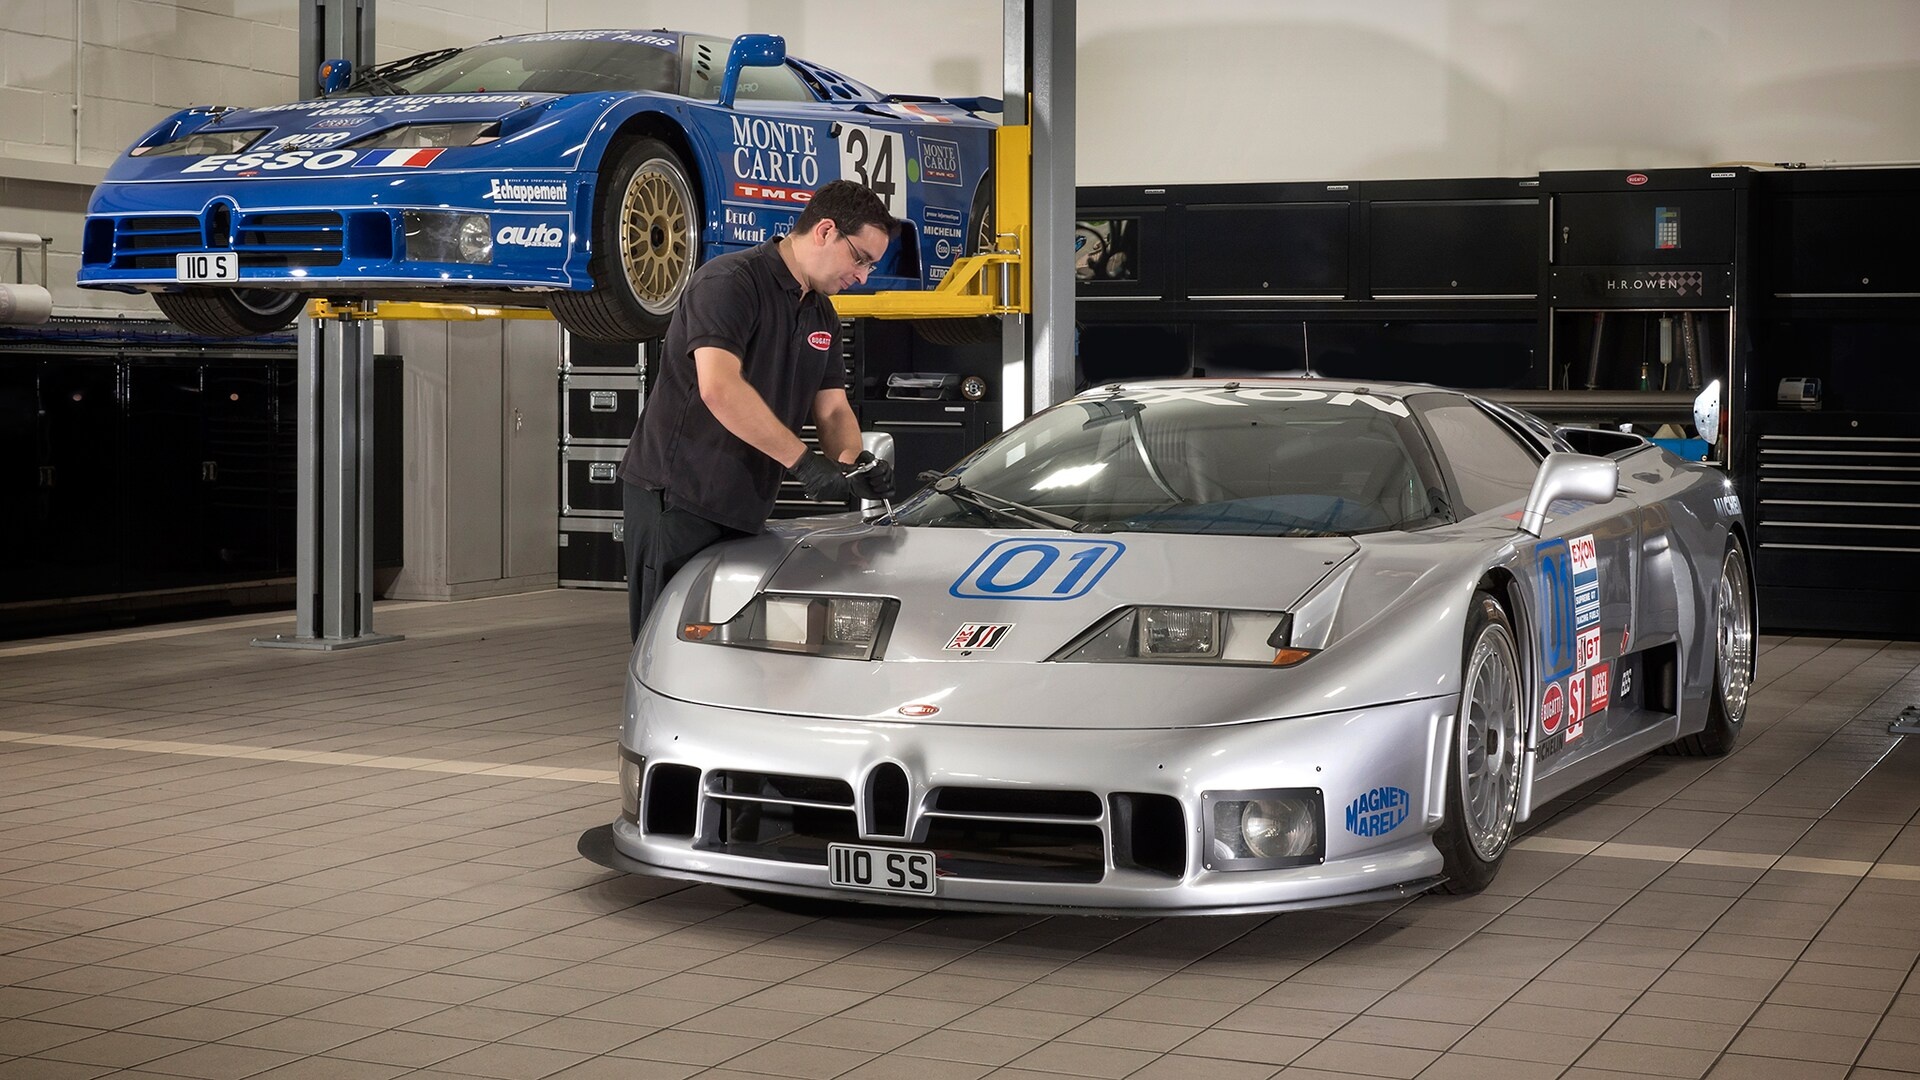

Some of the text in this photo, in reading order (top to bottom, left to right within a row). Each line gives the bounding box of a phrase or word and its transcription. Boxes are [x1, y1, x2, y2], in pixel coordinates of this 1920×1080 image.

[612, 33, 676, 47] PARIS
[267, 132, 351, 146] AUTO
[730, 115, 817, 156] MONTE
[180, 149, 358, 173] ESSO
[923, 143, 955, 160] MONTE
[924, 155, 957, 172] CARLO
[733, 147, 819, 186] CARLO
[846, 128, 896, 211] 34
[739, 186, 812, 201] TMC
[497, 223, 563, 245] auto
[923, 225, 962, 238] MICHELIN
[187, 256, 227, 279] 110 S
[1572, 539, 1595, 569] EXXON
[975, 544, 1108, 594] 01
[1542, 552, 1571, 669] 01
[1586, 635, 1600, 660] GT
[1591, 671, 1608, 701] DIESEL
[1543, 695, 1562, 721] BUGATTI
[1567, 677, 1585, 735] S1
[836, 848, 928, 890] 110 SS
